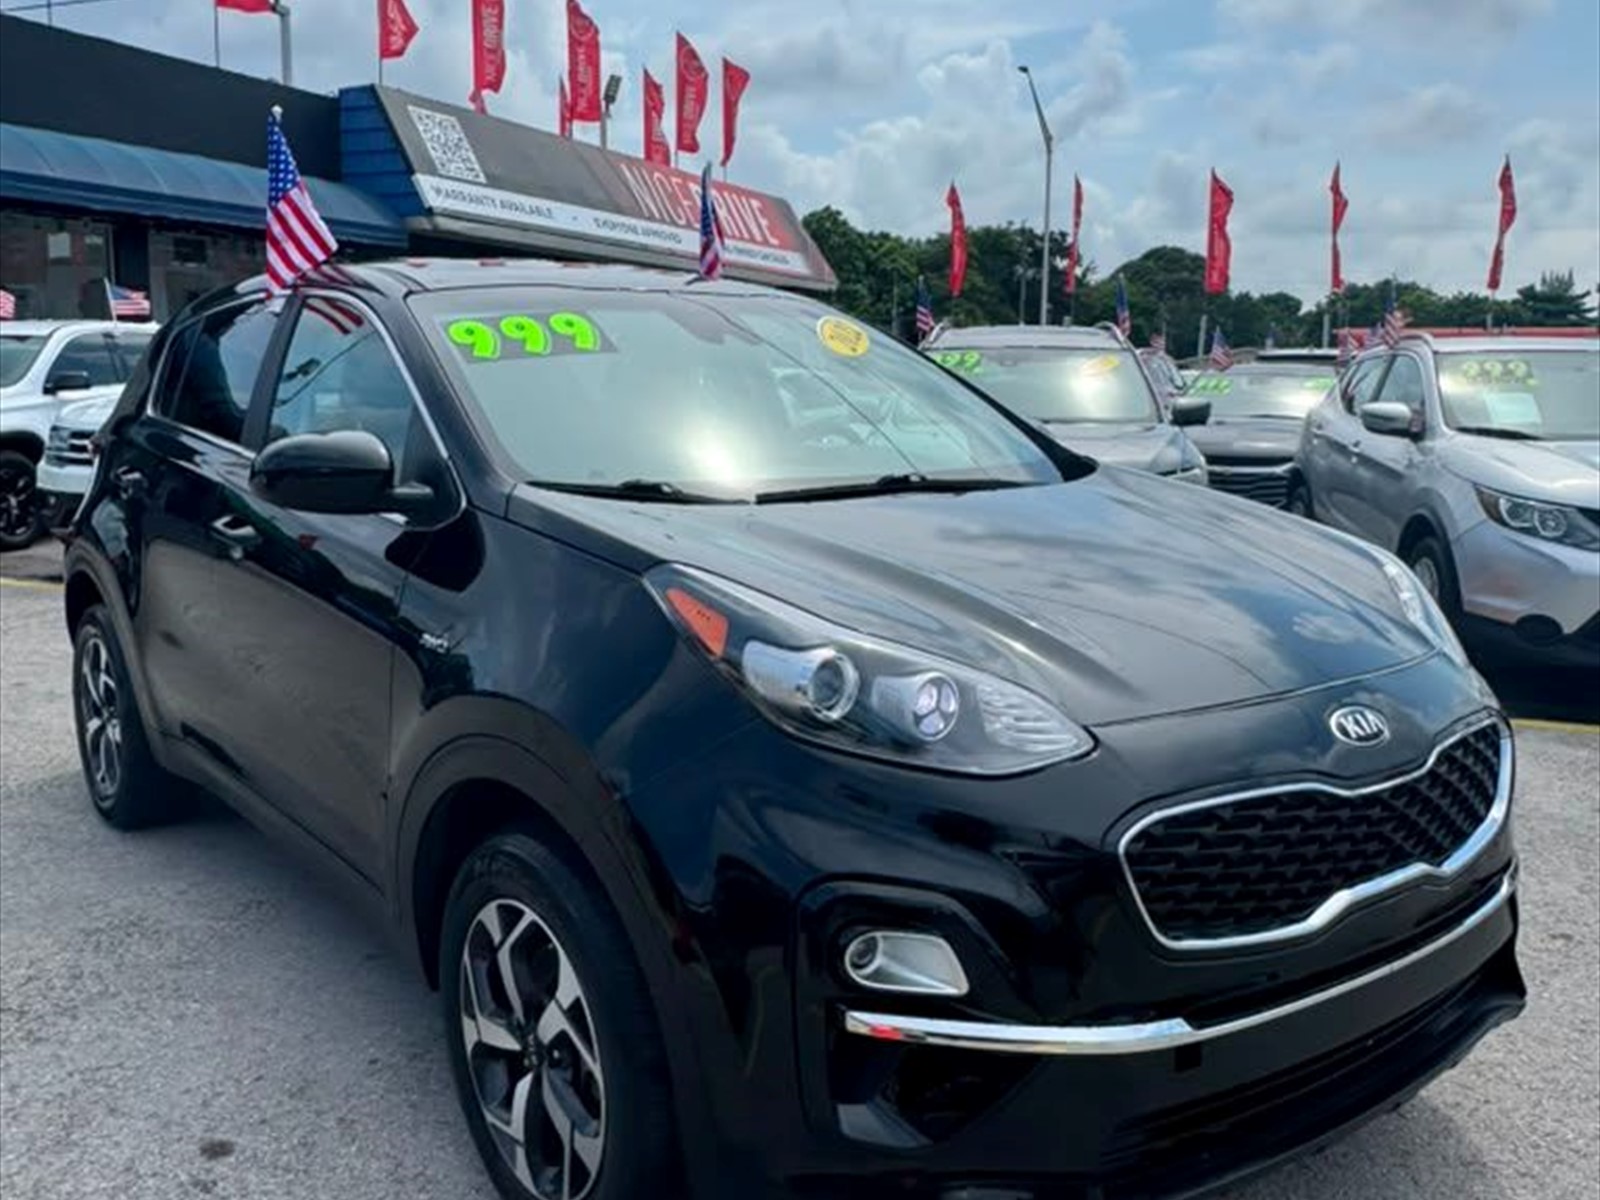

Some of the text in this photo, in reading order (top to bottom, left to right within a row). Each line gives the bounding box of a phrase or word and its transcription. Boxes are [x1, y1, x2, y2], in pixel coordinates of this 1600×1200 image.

[481, 4, 500, 49] DRIVE
[620, 163, 700, 229] NICE
[448, 312, 600, 359] 999
[1339, 709, 1384, 738] KIA
